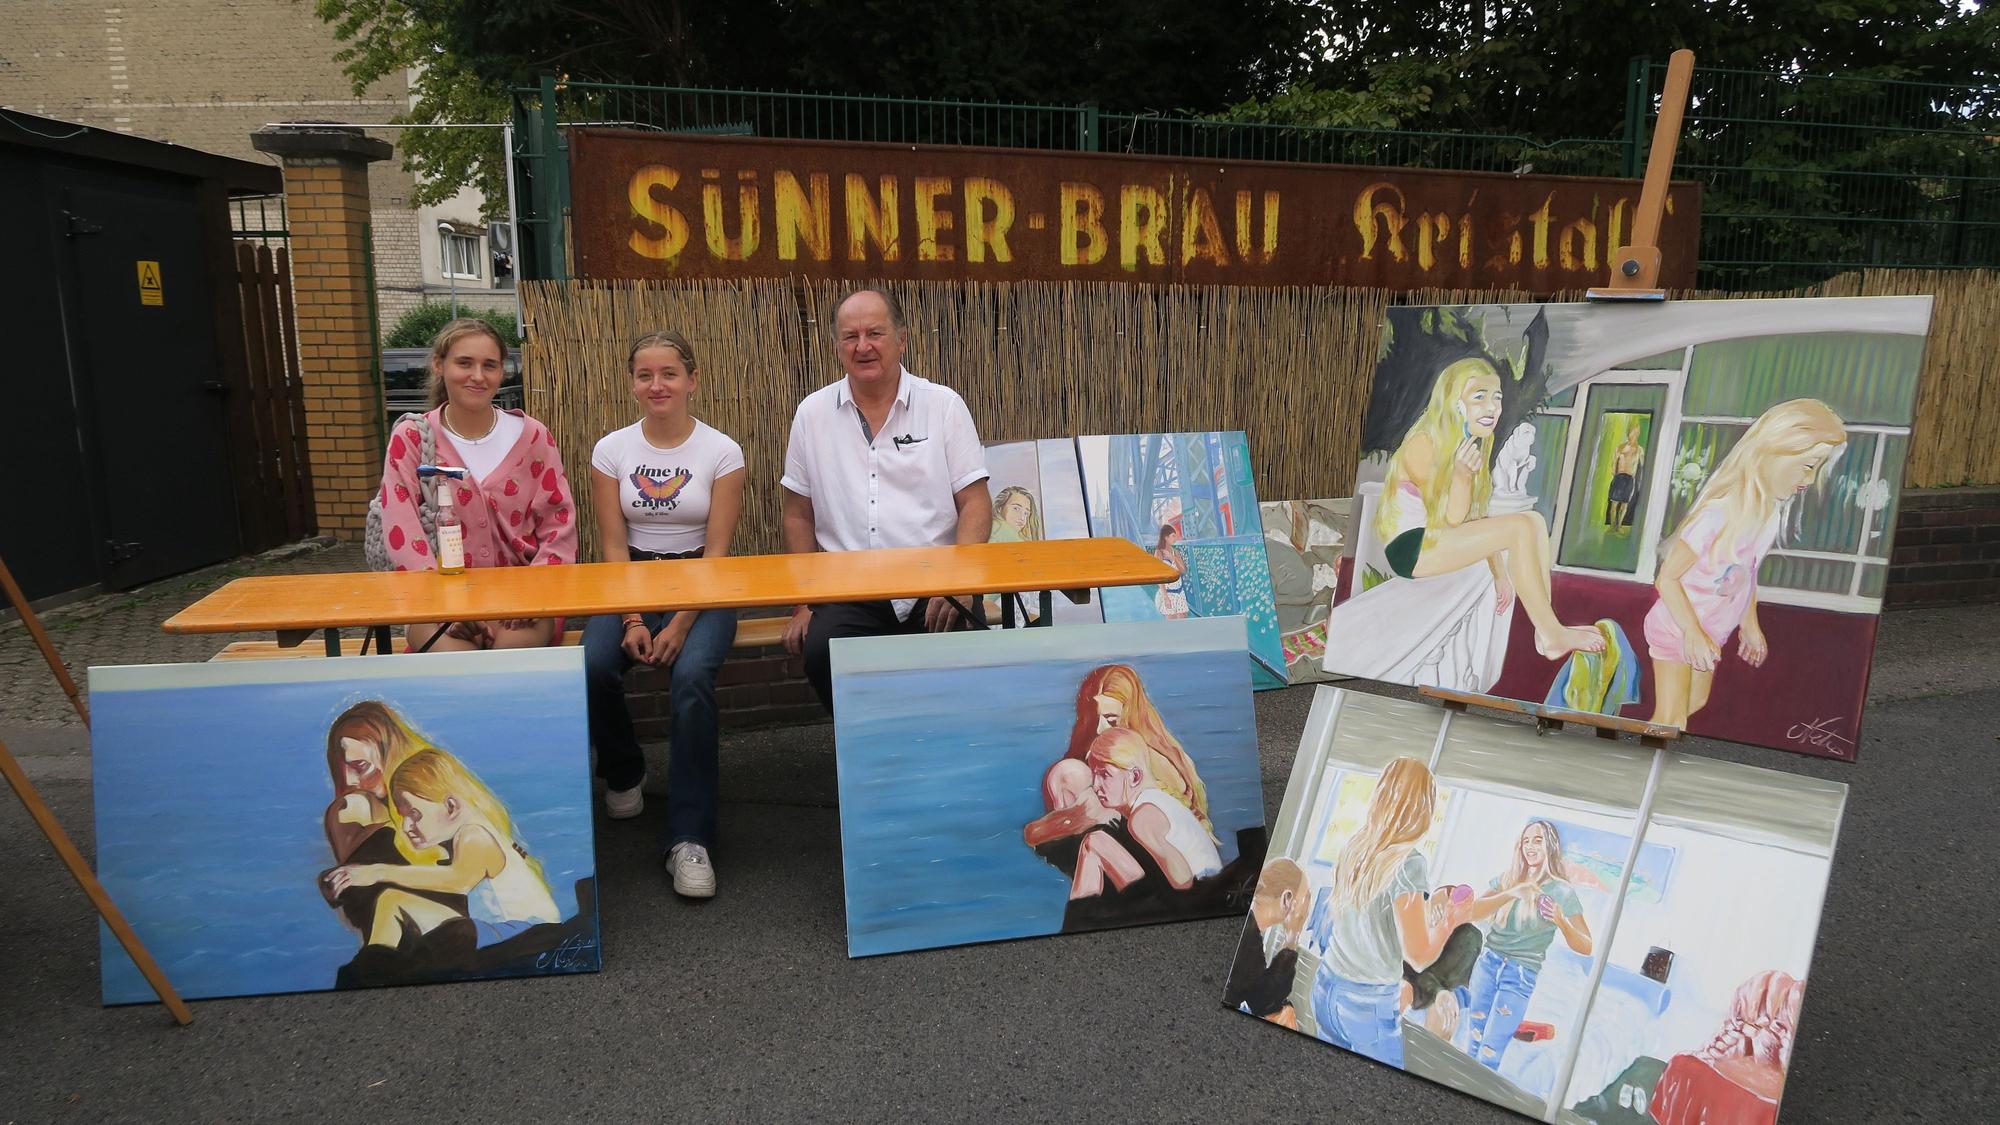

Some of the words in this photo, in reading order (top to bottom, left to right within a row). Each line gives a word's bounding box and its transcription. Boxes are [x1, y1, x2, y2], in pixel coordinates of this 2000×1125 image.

[634, 464, 671, 477] time
[675, 466, 689, 477] to
[632, 499, 680, 511] enjoy
